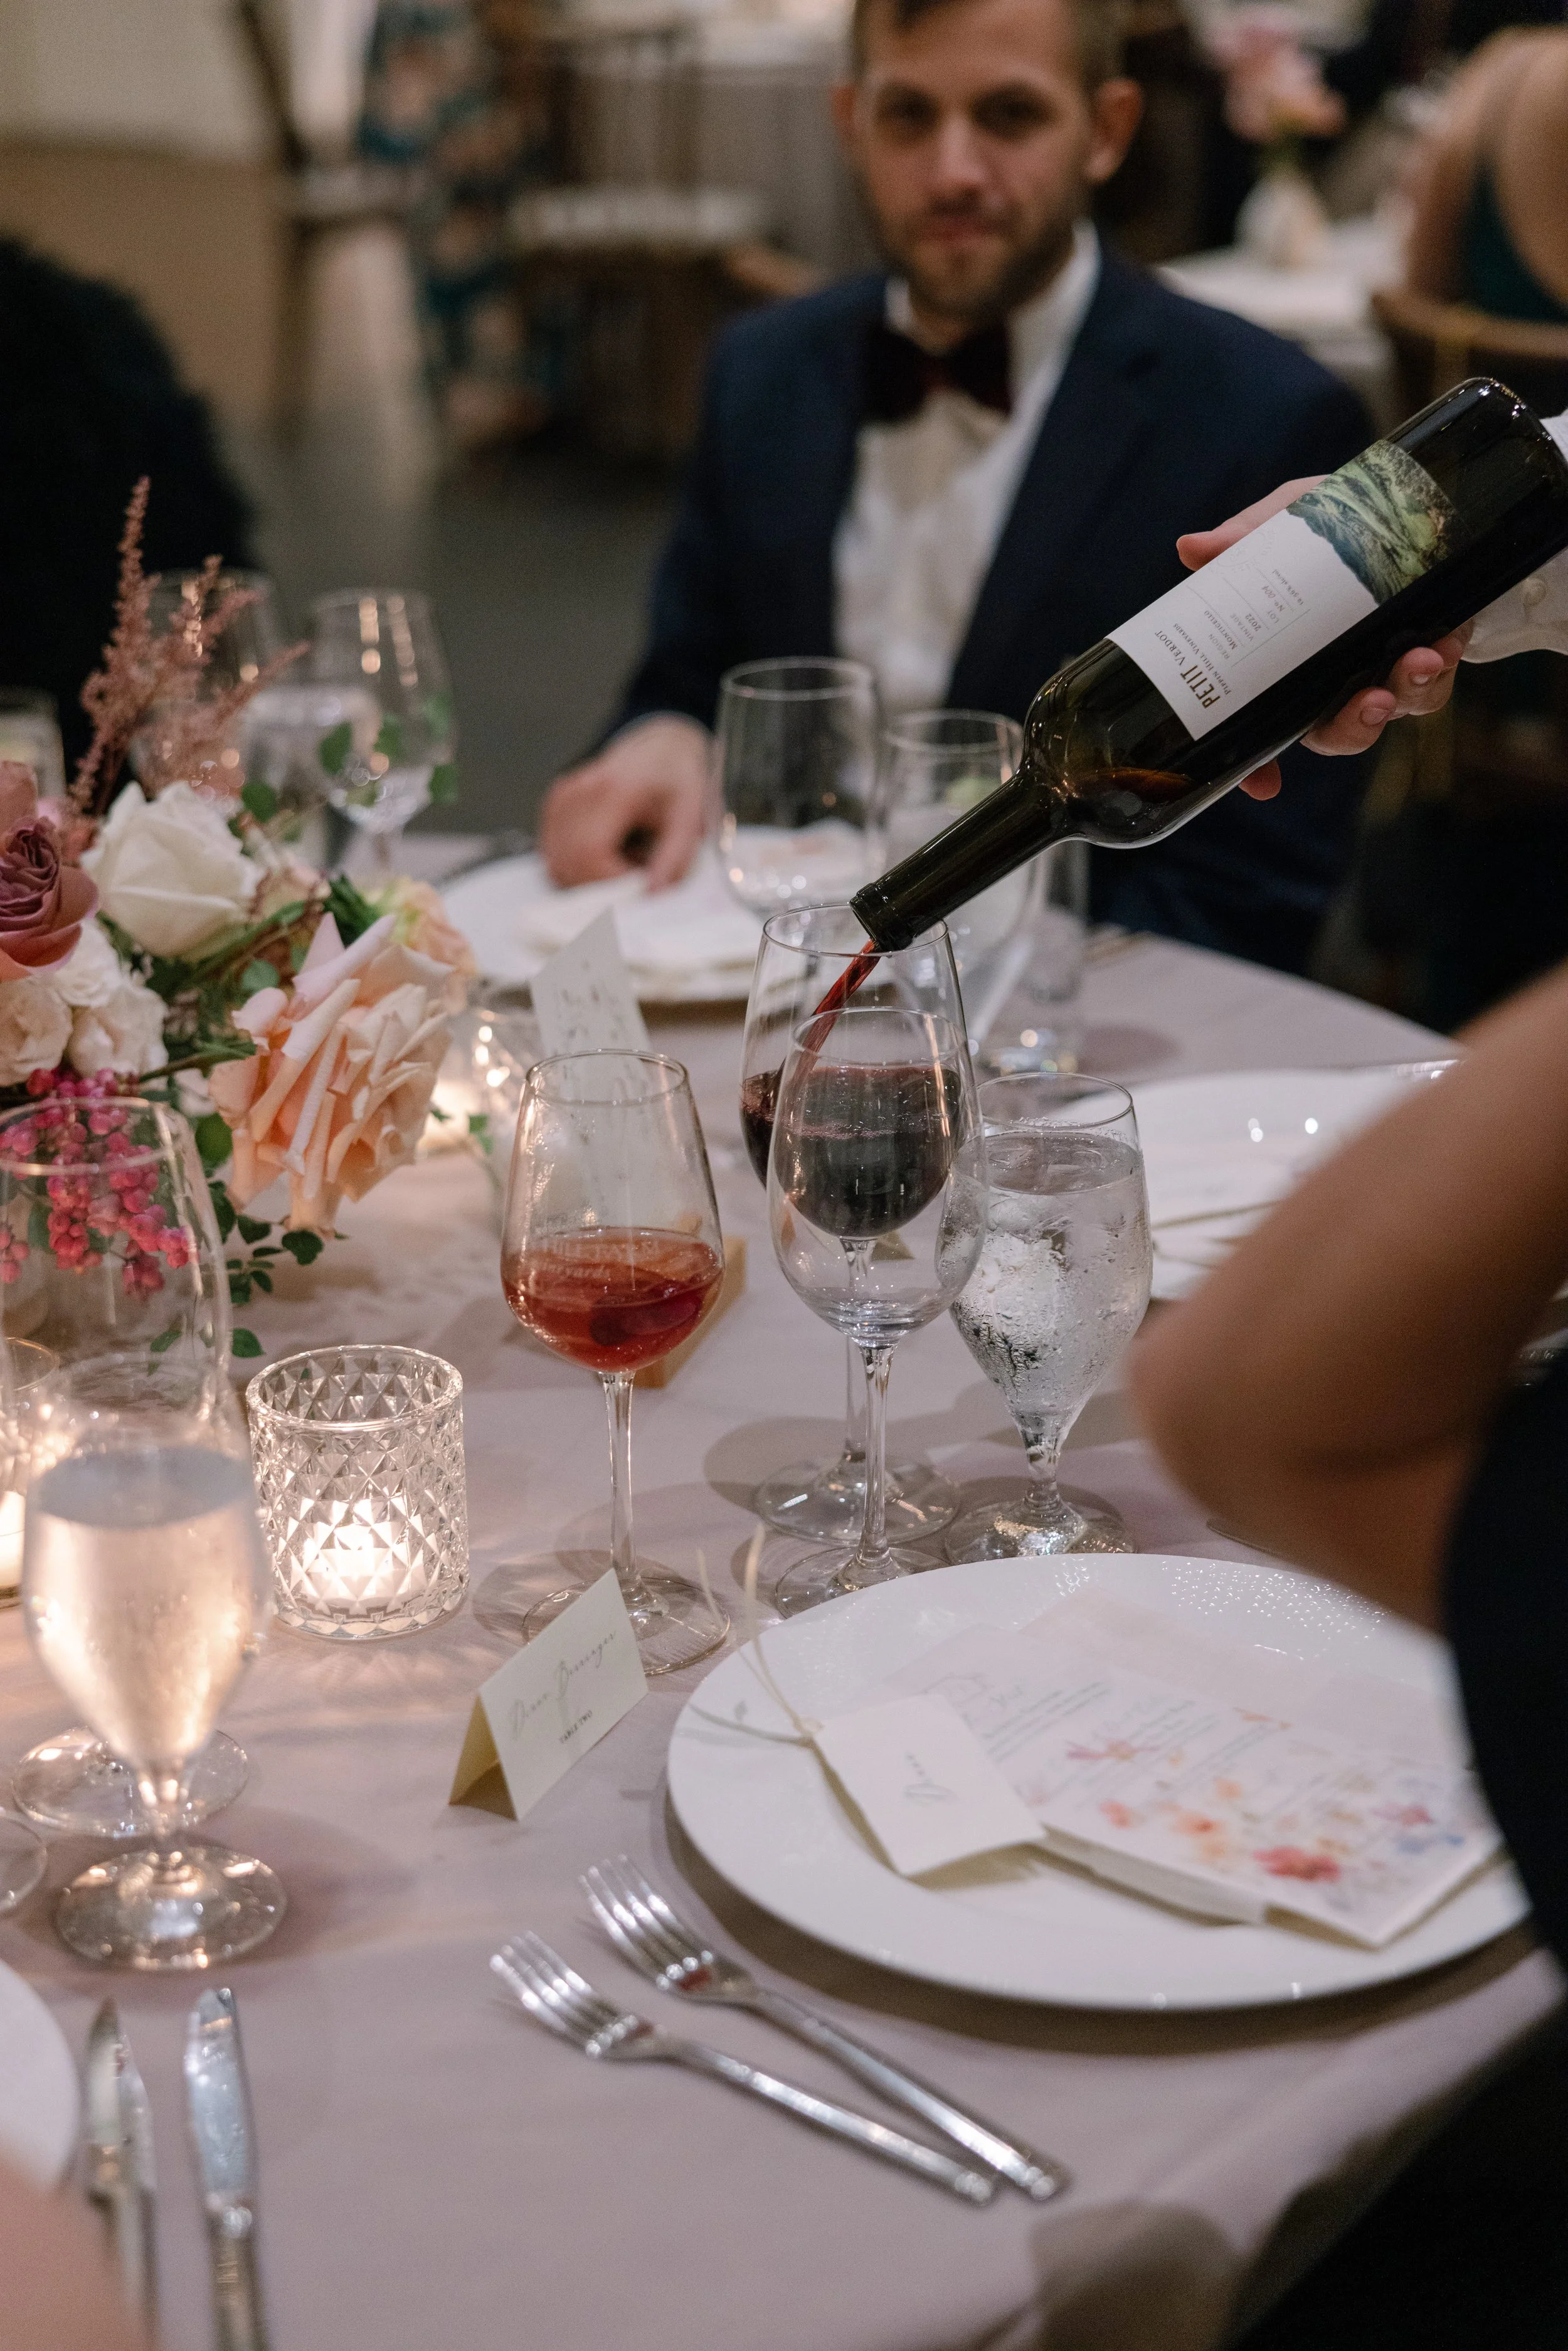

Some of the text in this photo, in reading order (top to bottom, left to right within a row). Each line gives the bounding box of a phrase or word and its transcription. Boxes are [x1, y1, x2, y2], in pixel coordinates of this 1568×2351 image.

[1229, 612, 1254, 642] VINTAGE
[1244, 612, 1261, 632] 2022
[1266, 610, 1279, 623] LOT
[1208, 632, 1230, 660] REGION
[1179, 664, 1221, 709] PETIT
[558, 1709, 593, 1744] TABLE TWO
